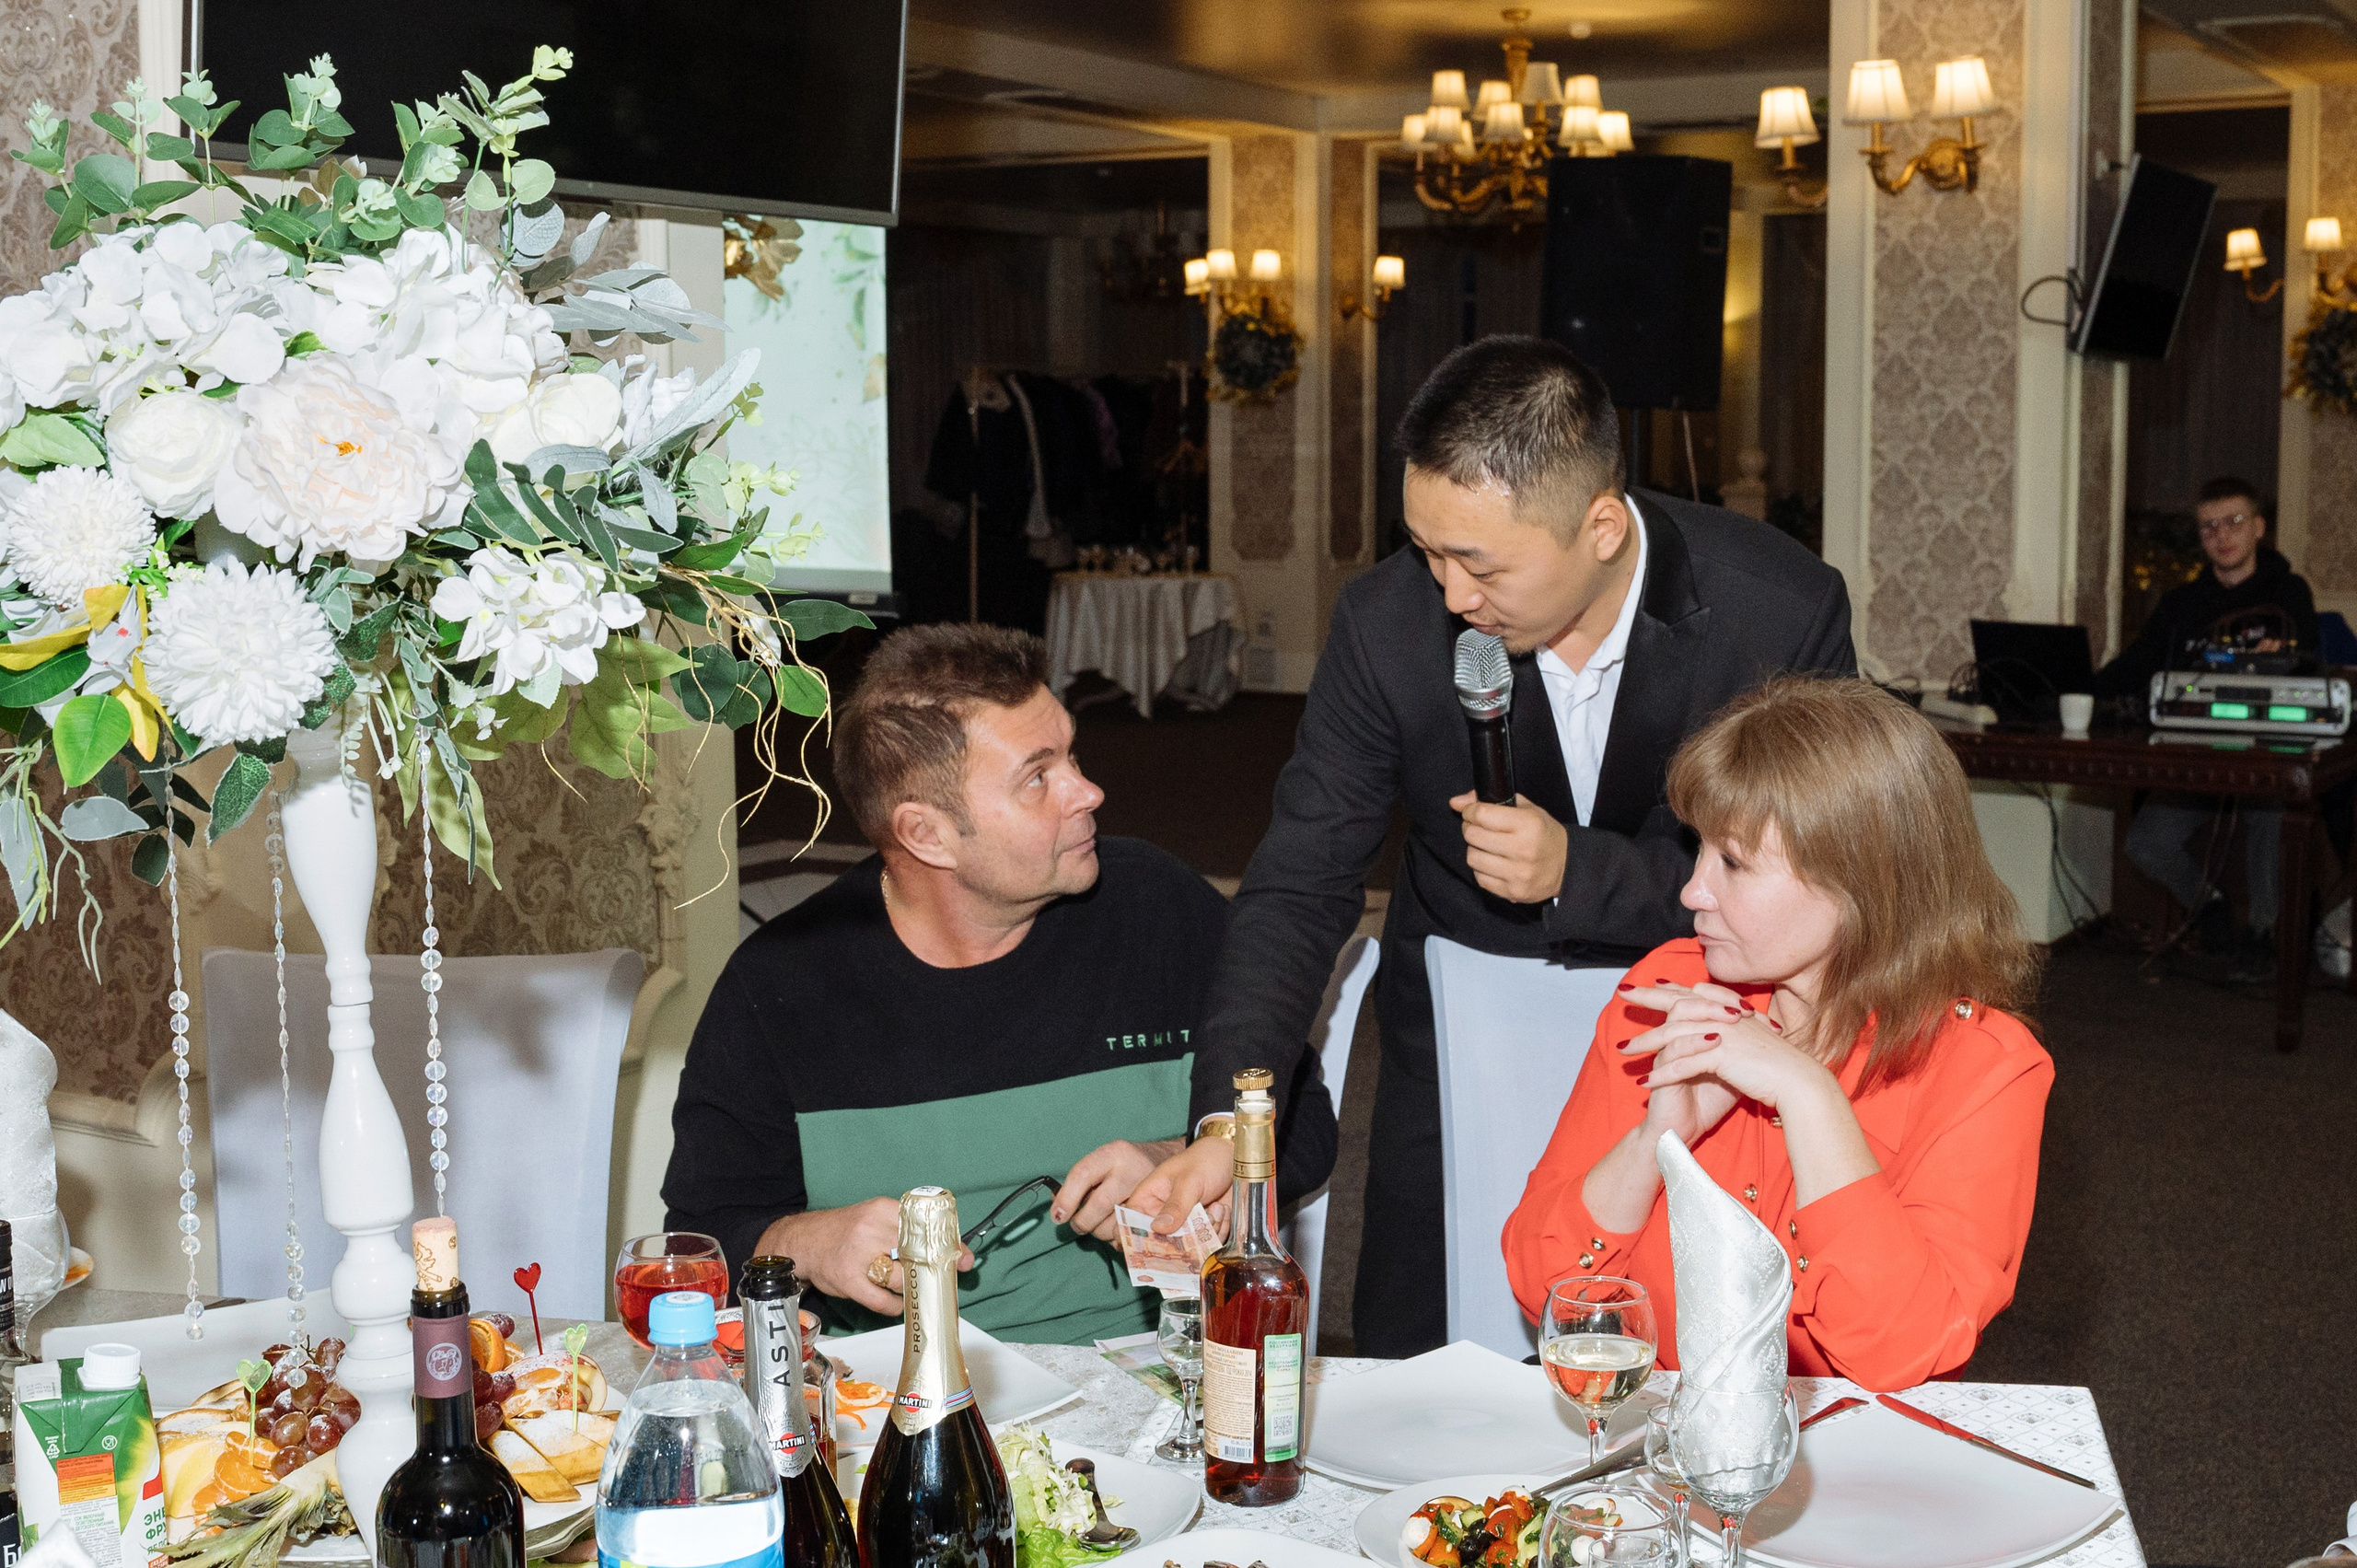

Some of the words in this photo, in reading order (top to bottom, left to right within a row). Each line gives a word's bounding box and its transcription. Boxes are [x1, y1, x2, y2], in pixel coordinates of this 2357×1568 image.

[1107, 1029, 1190, 1051] TERMIT
[911, 1268, 921, 1353] PROSECCO
[768, 1304, 791, 1388] ASTI
[899, 1396, 930, 1408] MARTINI
